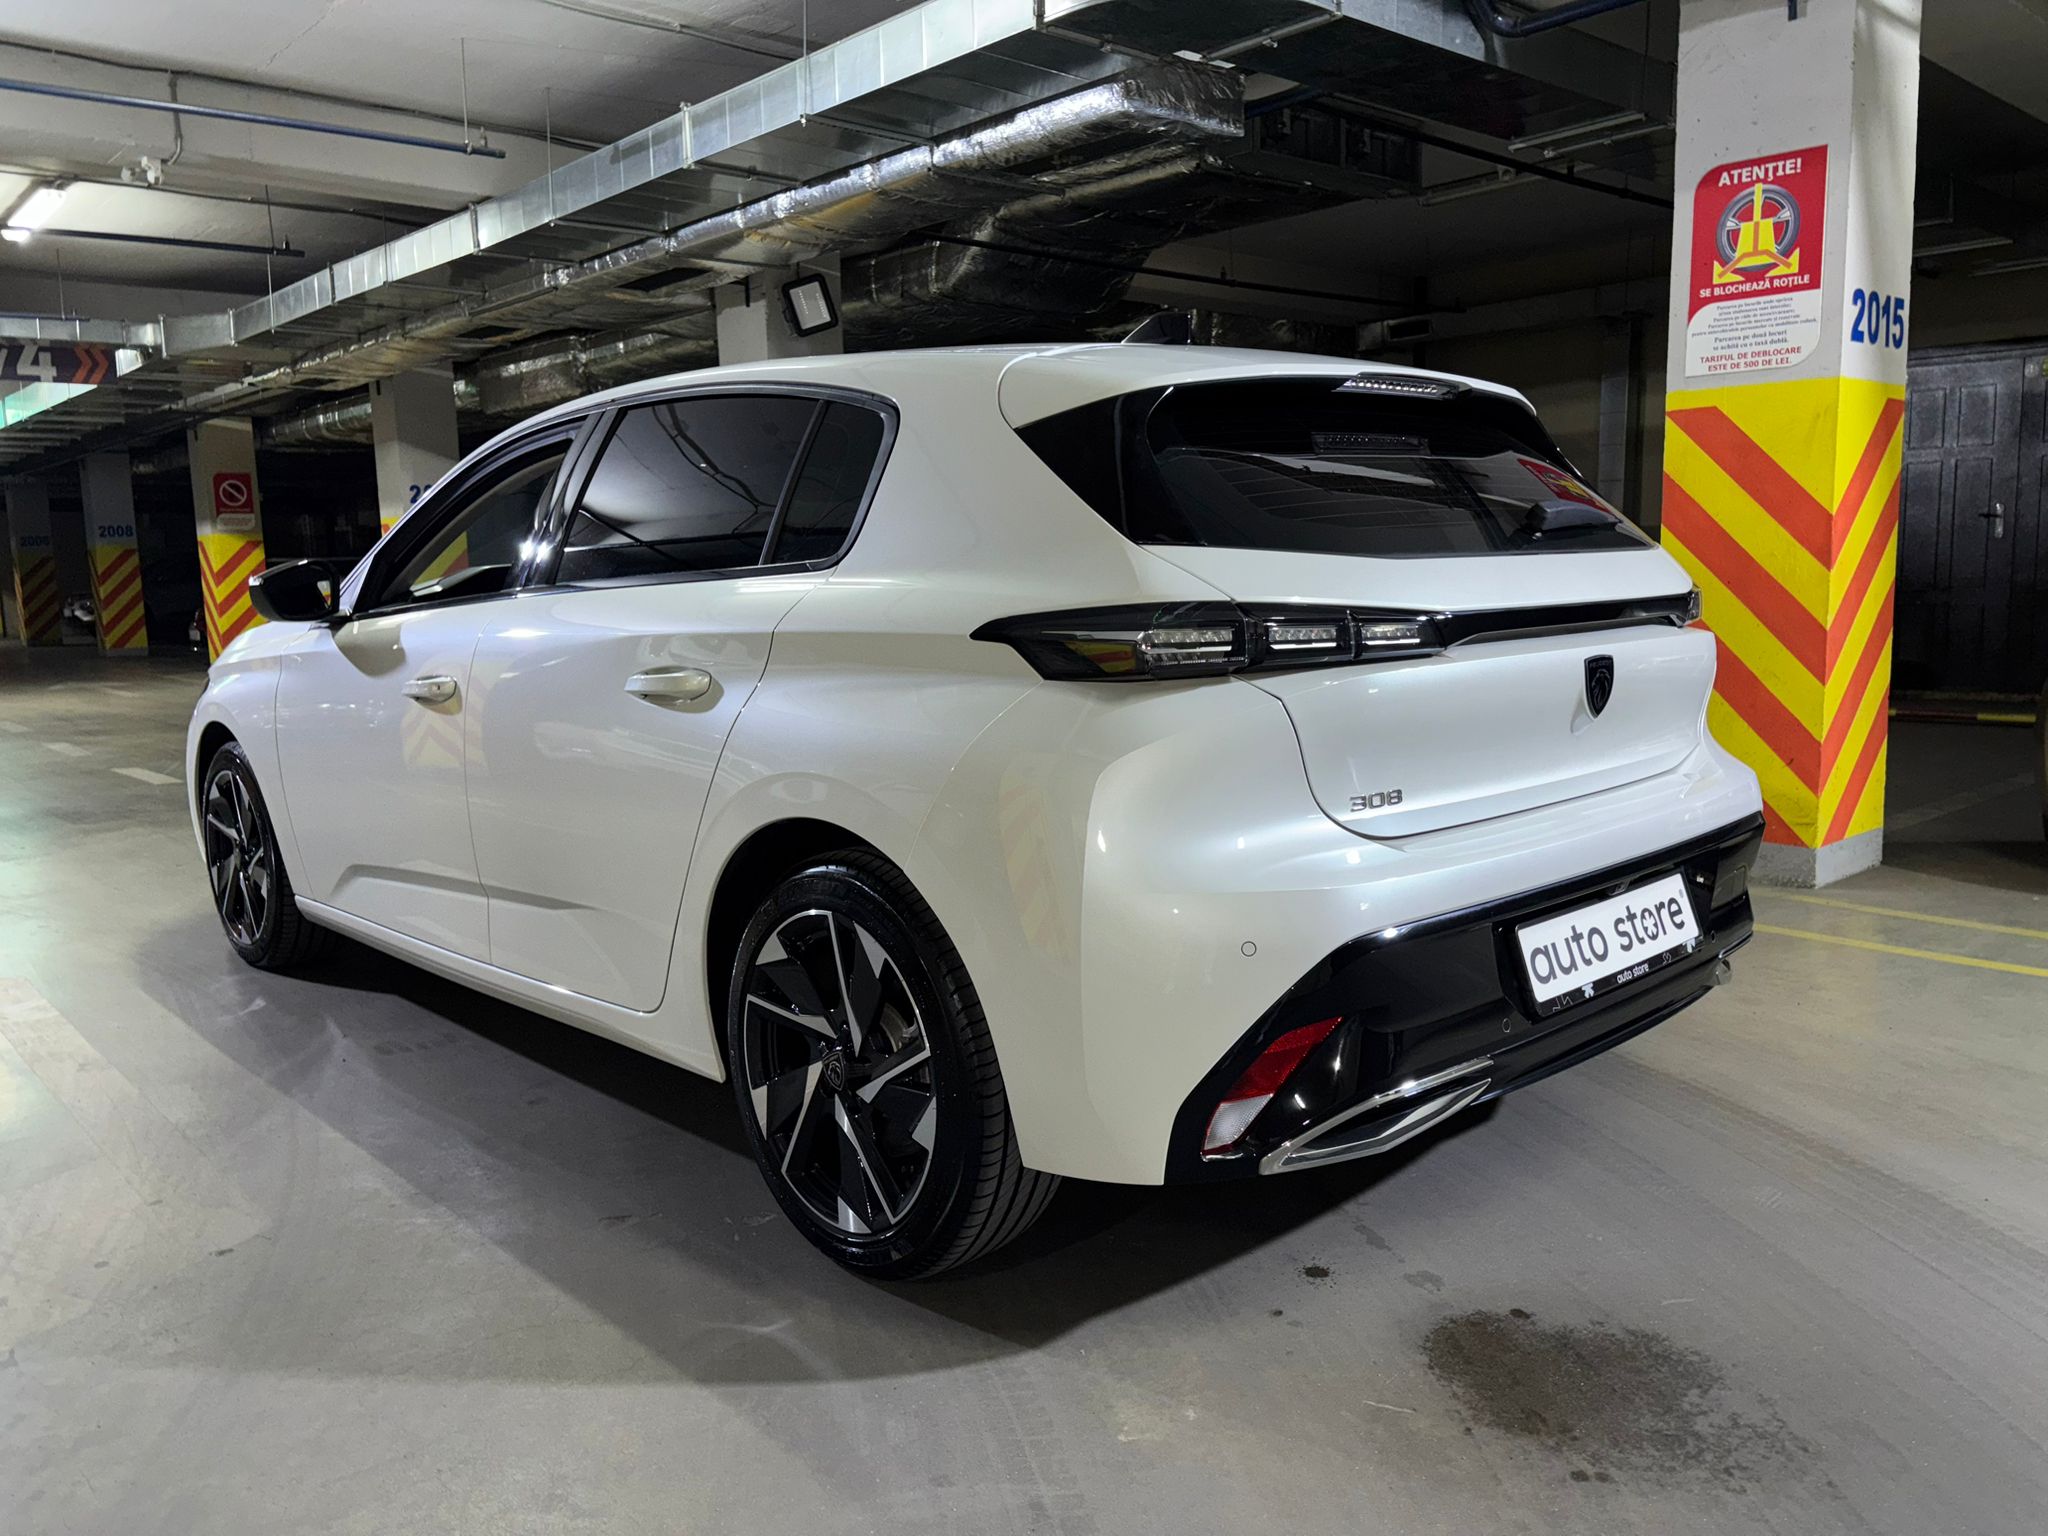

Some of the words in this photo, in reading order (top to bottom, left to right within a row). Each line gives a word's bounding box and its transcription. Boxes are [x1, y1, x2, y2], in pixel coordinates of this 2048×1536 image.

[1700, 288, 1712, 298] SE
[1714, 279, 1771, 296] BLOCHEAZĂ
[1850, 288, 1905, 350] 2015
[1700, 354, 1734, 364] TARIFUL
[1738, 352, 1748, 360] DE
[1751, 346, 1802, 358] DEBLOCARE
[1708, 364, 1727, 372] ESTE
[1730, 362, 1741, 370] DE
[1744, 360, 1759, 368] 500
[1776, 357, 1792, 365] LEI.
[99, 525, 134, 537] 2008
[1349, 789, 1403, 812] 308
[1530, 924, 1609, 985] auto
[1613, 897, 1686, 952] store
[1616, 970, 1632, 984] auto
[1632, 962, 1649, 976] store
